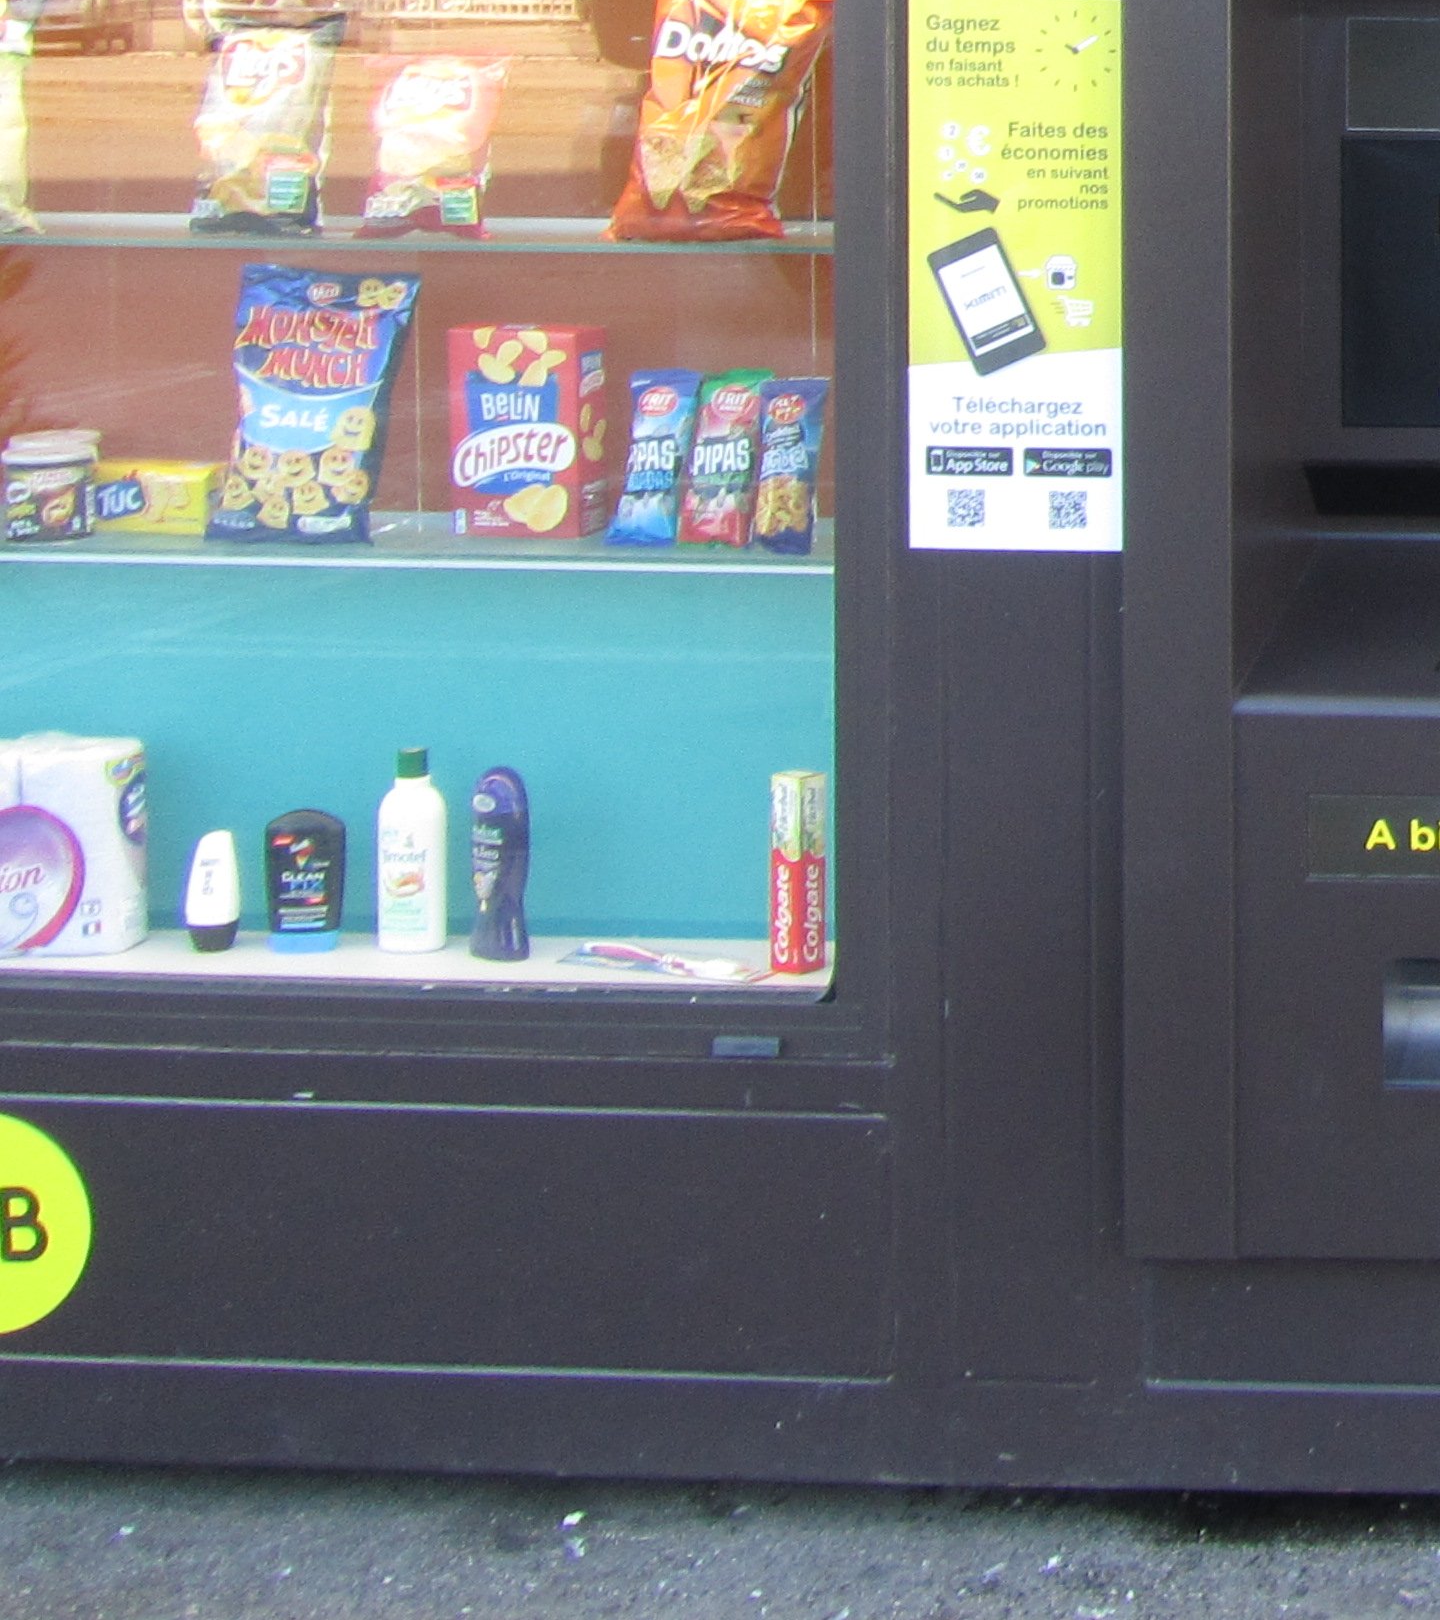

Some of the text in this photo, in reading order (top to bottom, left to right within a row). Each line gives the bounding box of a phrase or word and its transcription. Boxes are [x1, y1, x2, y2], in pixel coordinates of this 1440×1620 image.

[925, 14, 1001, 35] Gagnez
[925, 37, 1016, 57] du temps
[926, 58, 1003, 72] en faisant
[925, 75, 952, 87] vos
[956, 73, 1010, 88] achats
[1008, 121, 1109, 139] Faites des
[1001, 144, 1109, 161] économies
[1026, 166, 1110, 180] en suivant
[1079, 184, 1109, 195] nos
[1017, 196, 1110, 213] promotions
[233, 305, 380, 354] MONSTER
[255, 347, 373, 389] MUNCH
[951, 396, 1083, 419] Téléchargez
[929, 419, 1107, 439] votre application
[691, 438, 751, 476] PIPAS
[945, 458, 1009, 474] App Store
[1041, 459, 1083, 475] Google
[98, 484, 143, 517] TUC
[1365, 818, 1396, 851] A
[774, 863, 793, 964] Colgate
[803, 863, 822, 962] Colgate
